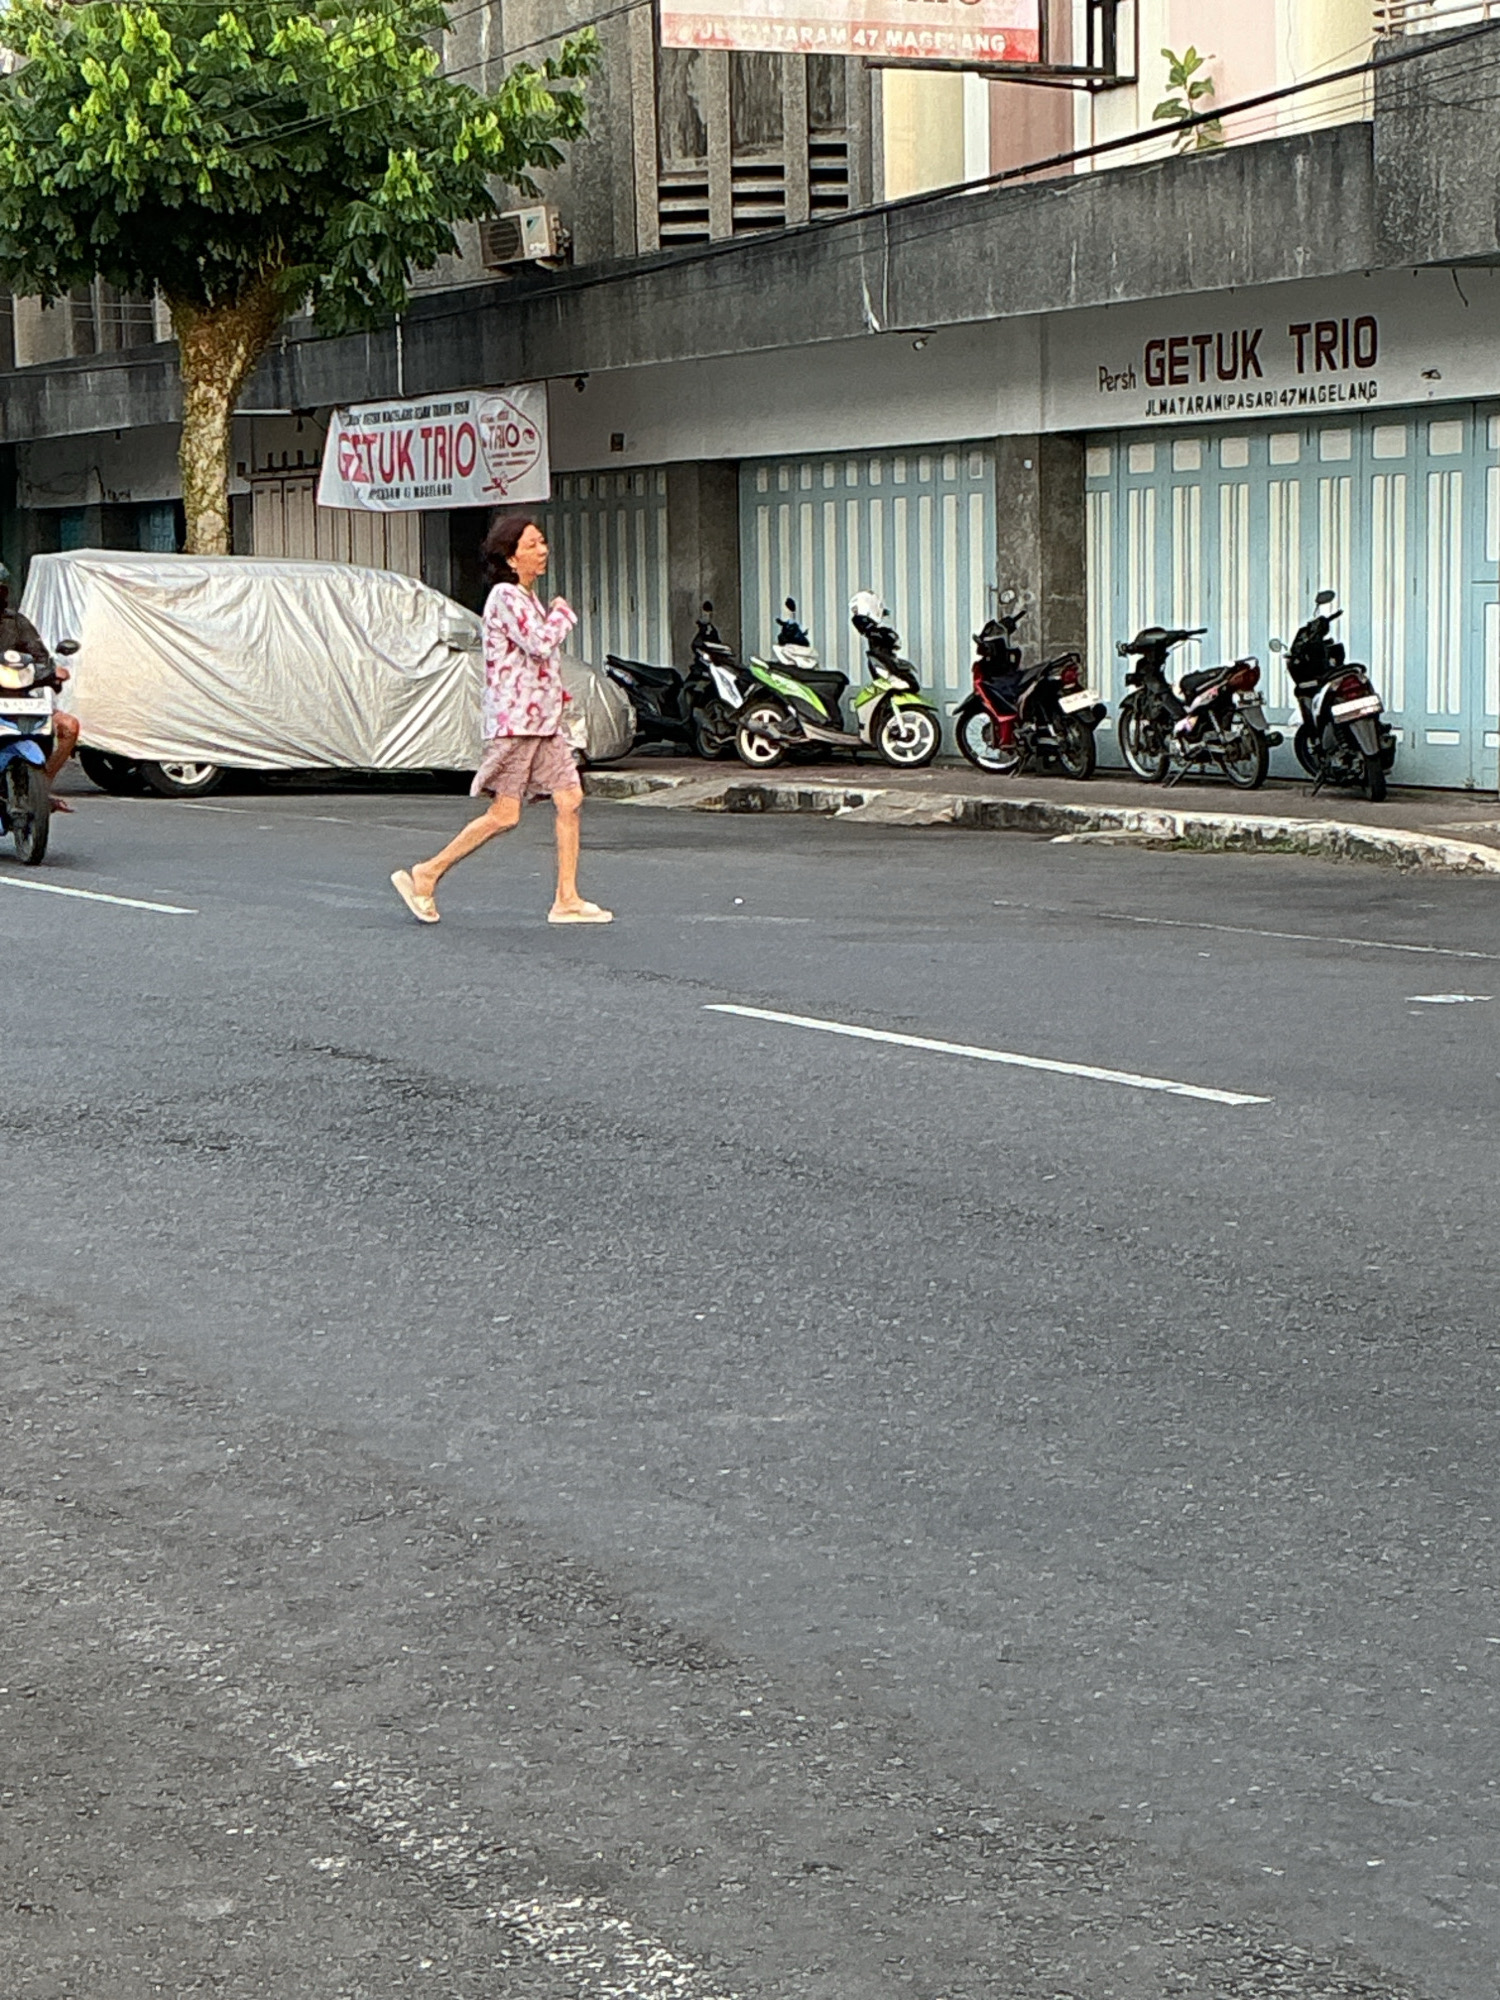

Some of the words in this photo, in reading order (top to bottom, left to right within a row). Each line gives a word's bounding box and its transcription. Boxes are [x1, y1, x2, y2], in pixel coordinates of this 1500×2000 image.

[741, 23, 847, 45] TARAM
[853, 28, 879, 46] 47
[1098, 364, 1137, 392] Persh
[1143, 327, 1264, 388] GETUK
[1289, 315, 1378, 375] TRIO
[338, 428, 415, 485] GETUK
[420, 421, 477, 479] TRIO
